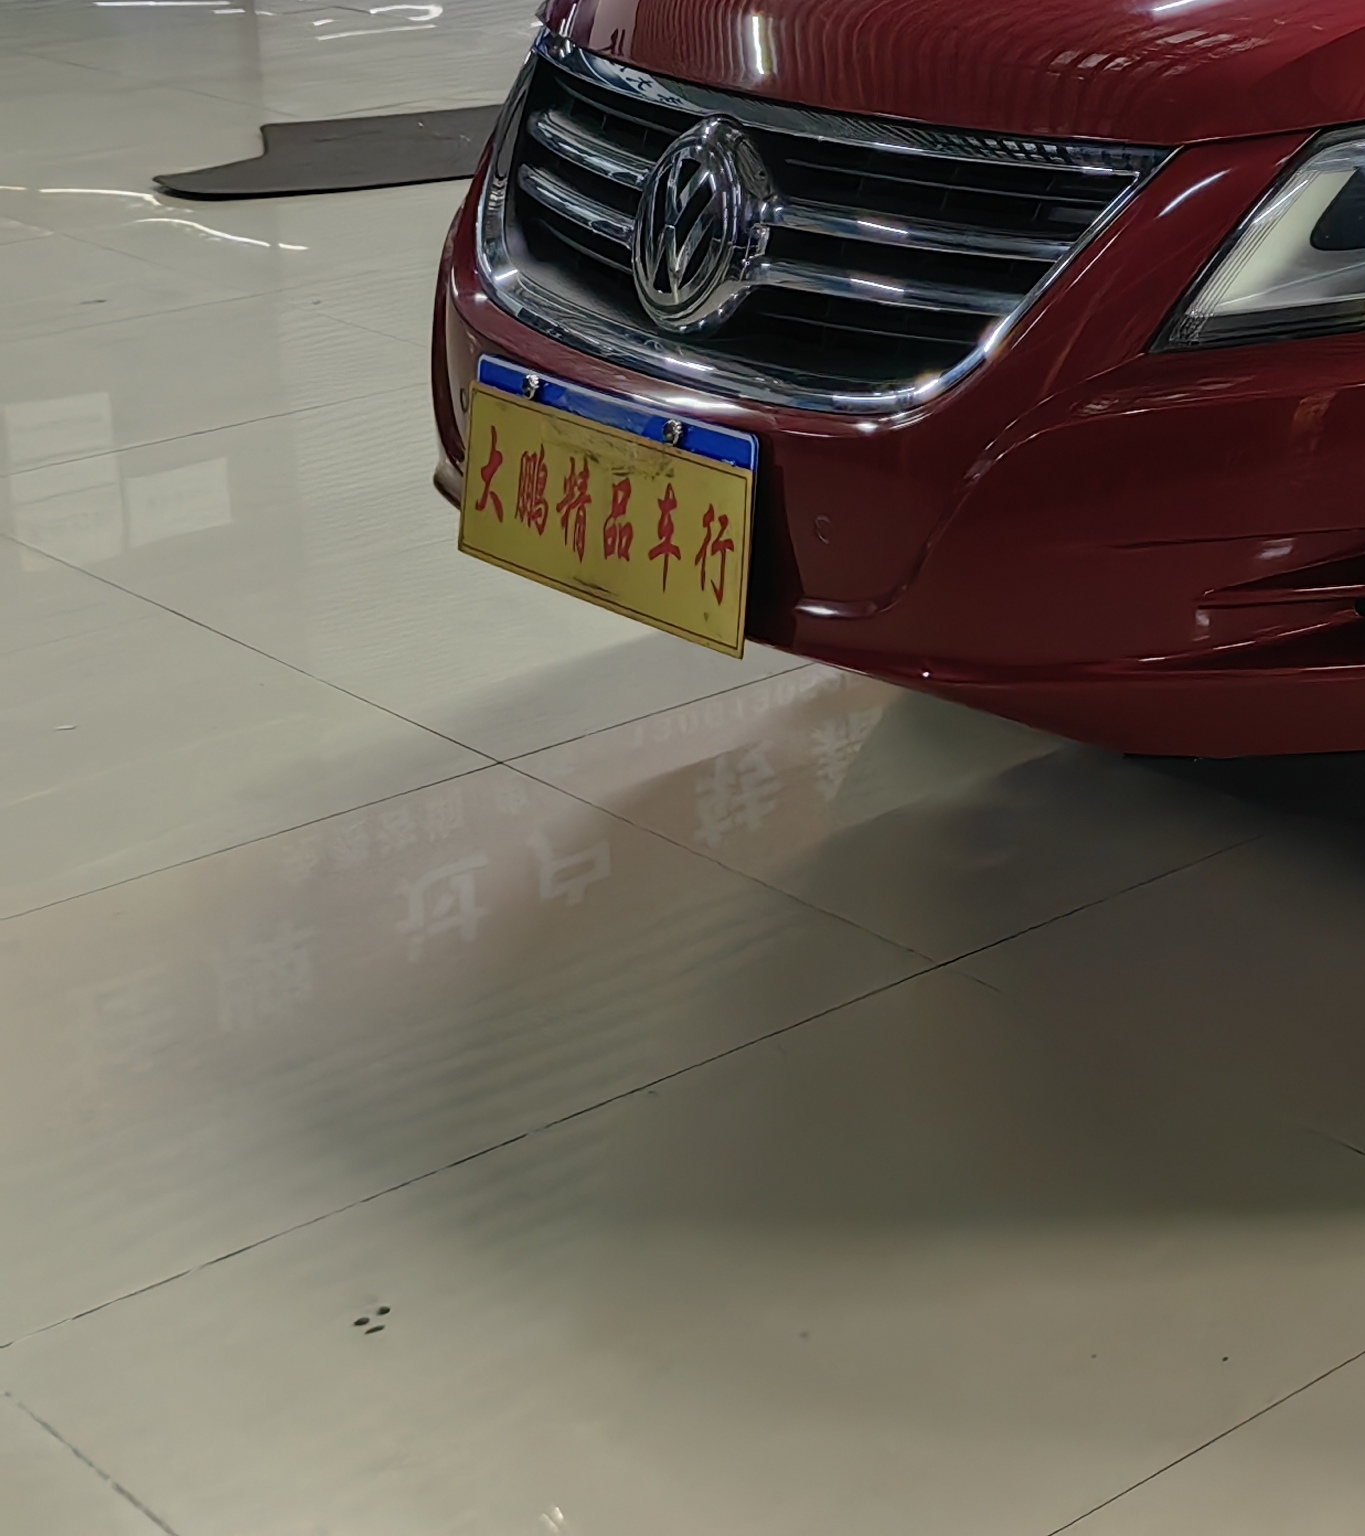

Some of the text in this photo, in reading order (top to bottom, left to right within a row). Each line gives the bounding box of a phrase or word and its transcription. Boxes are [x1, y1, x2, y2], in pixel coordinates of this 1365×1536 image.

[475, 425, 735, 606] 大鹏精品车行
